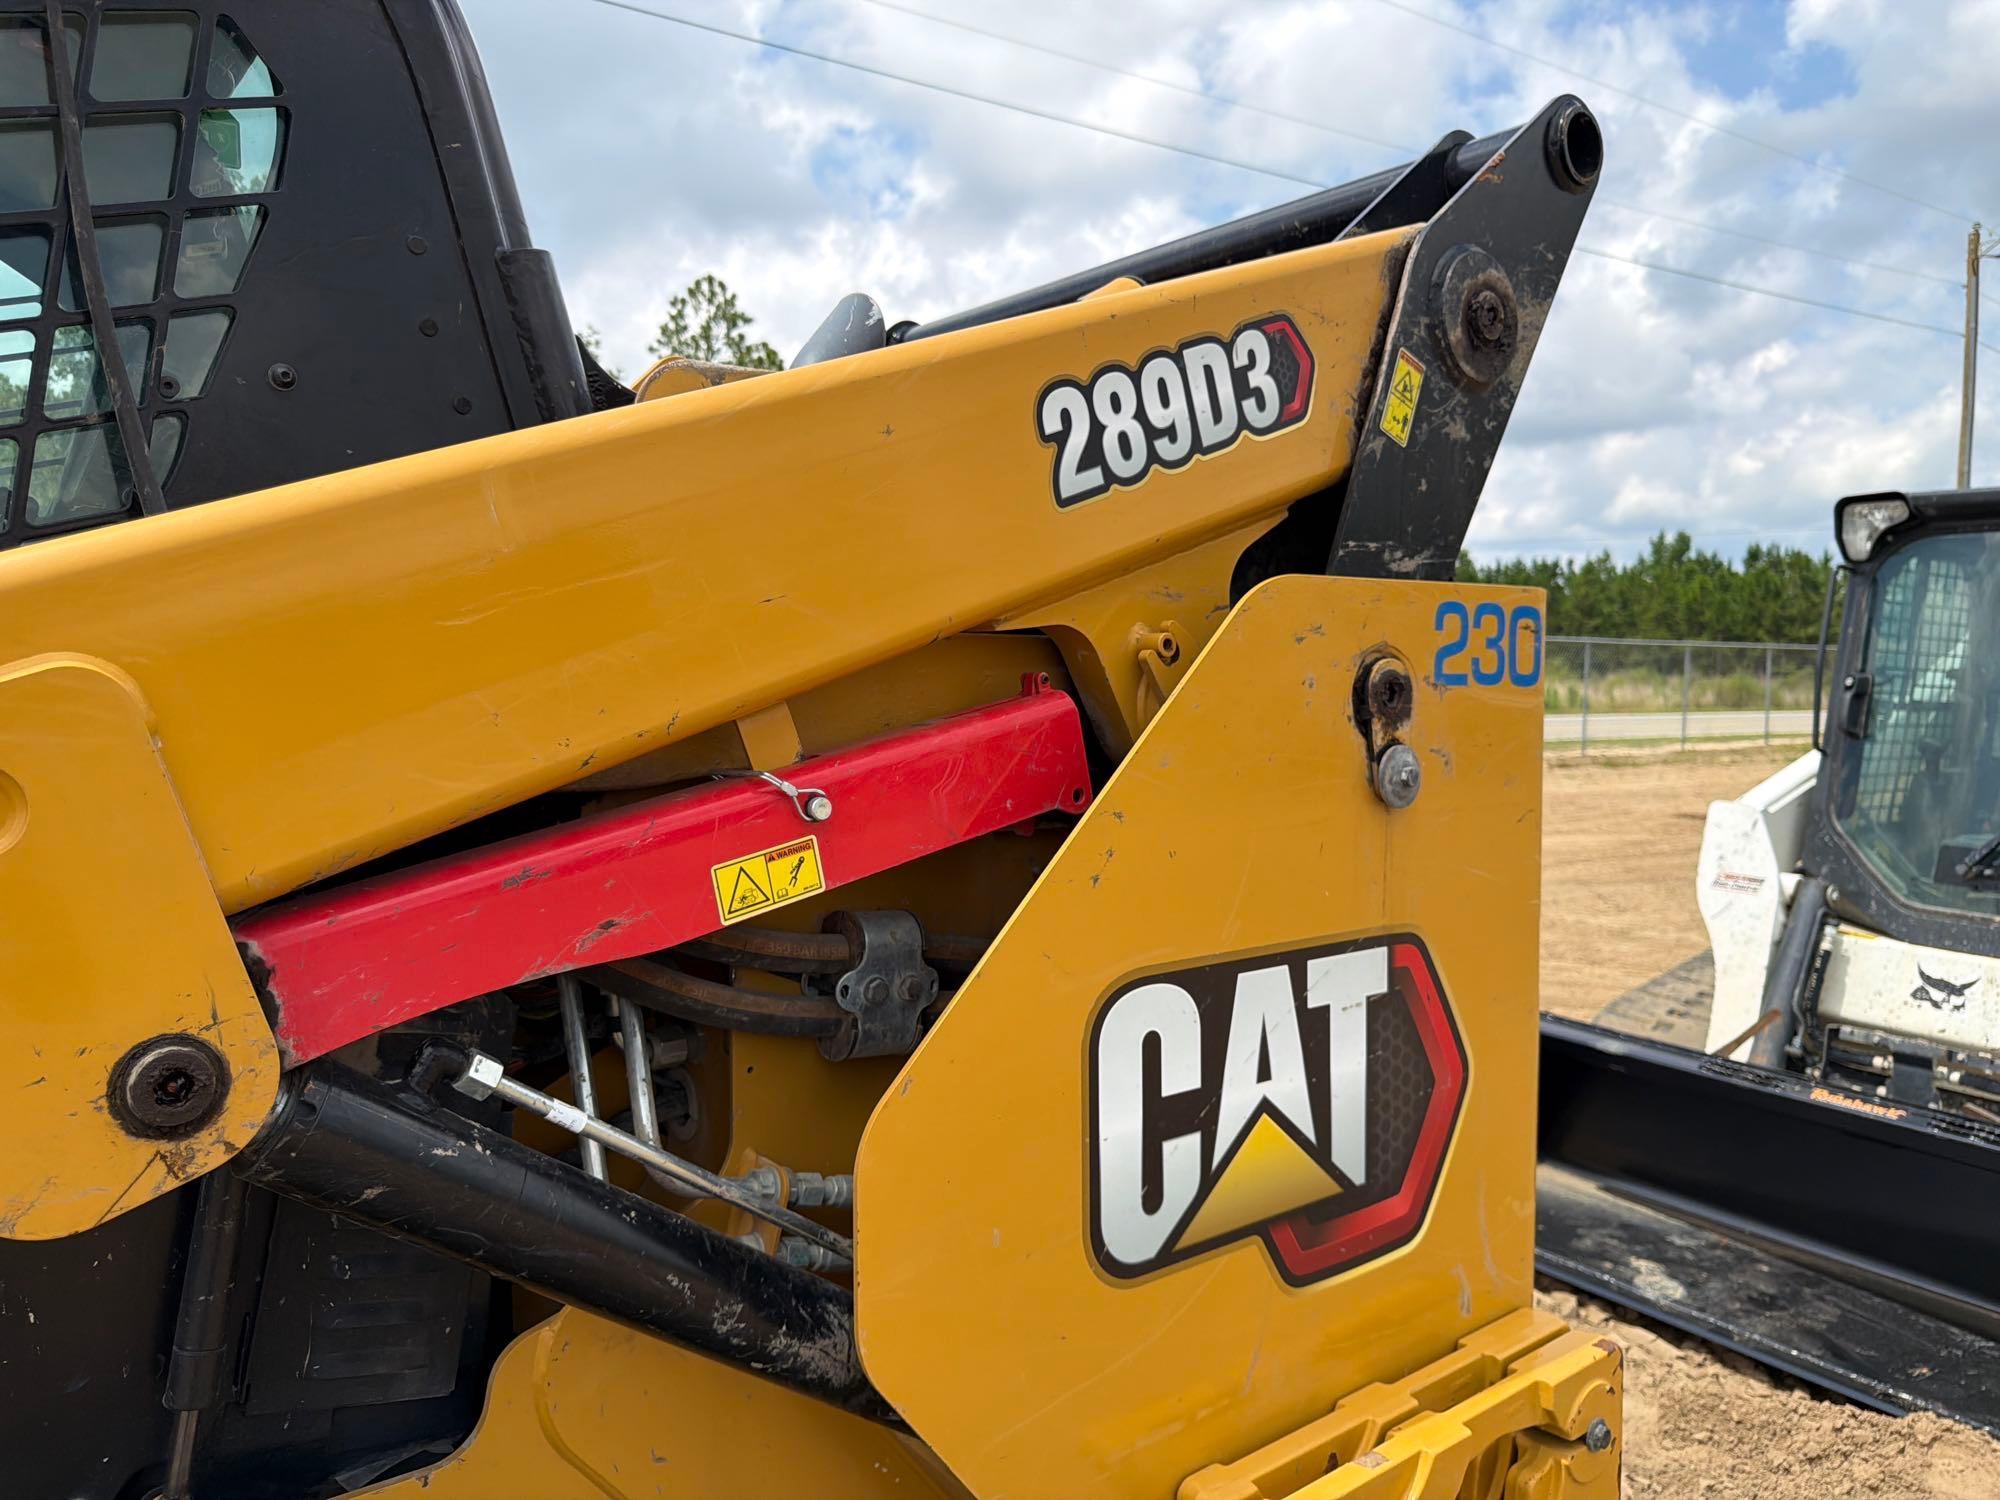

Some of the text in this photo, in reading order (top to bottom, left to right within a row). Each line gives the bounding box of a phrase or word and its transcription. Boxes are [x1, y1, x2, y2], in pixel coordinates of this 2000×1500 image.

[1042, 329, 1281, 500] 289D3
[1434, 601, 1541, 688] 230
[777, 843, 812, 859] WARNING
[1098, 946, 1388, 1264] CAT
